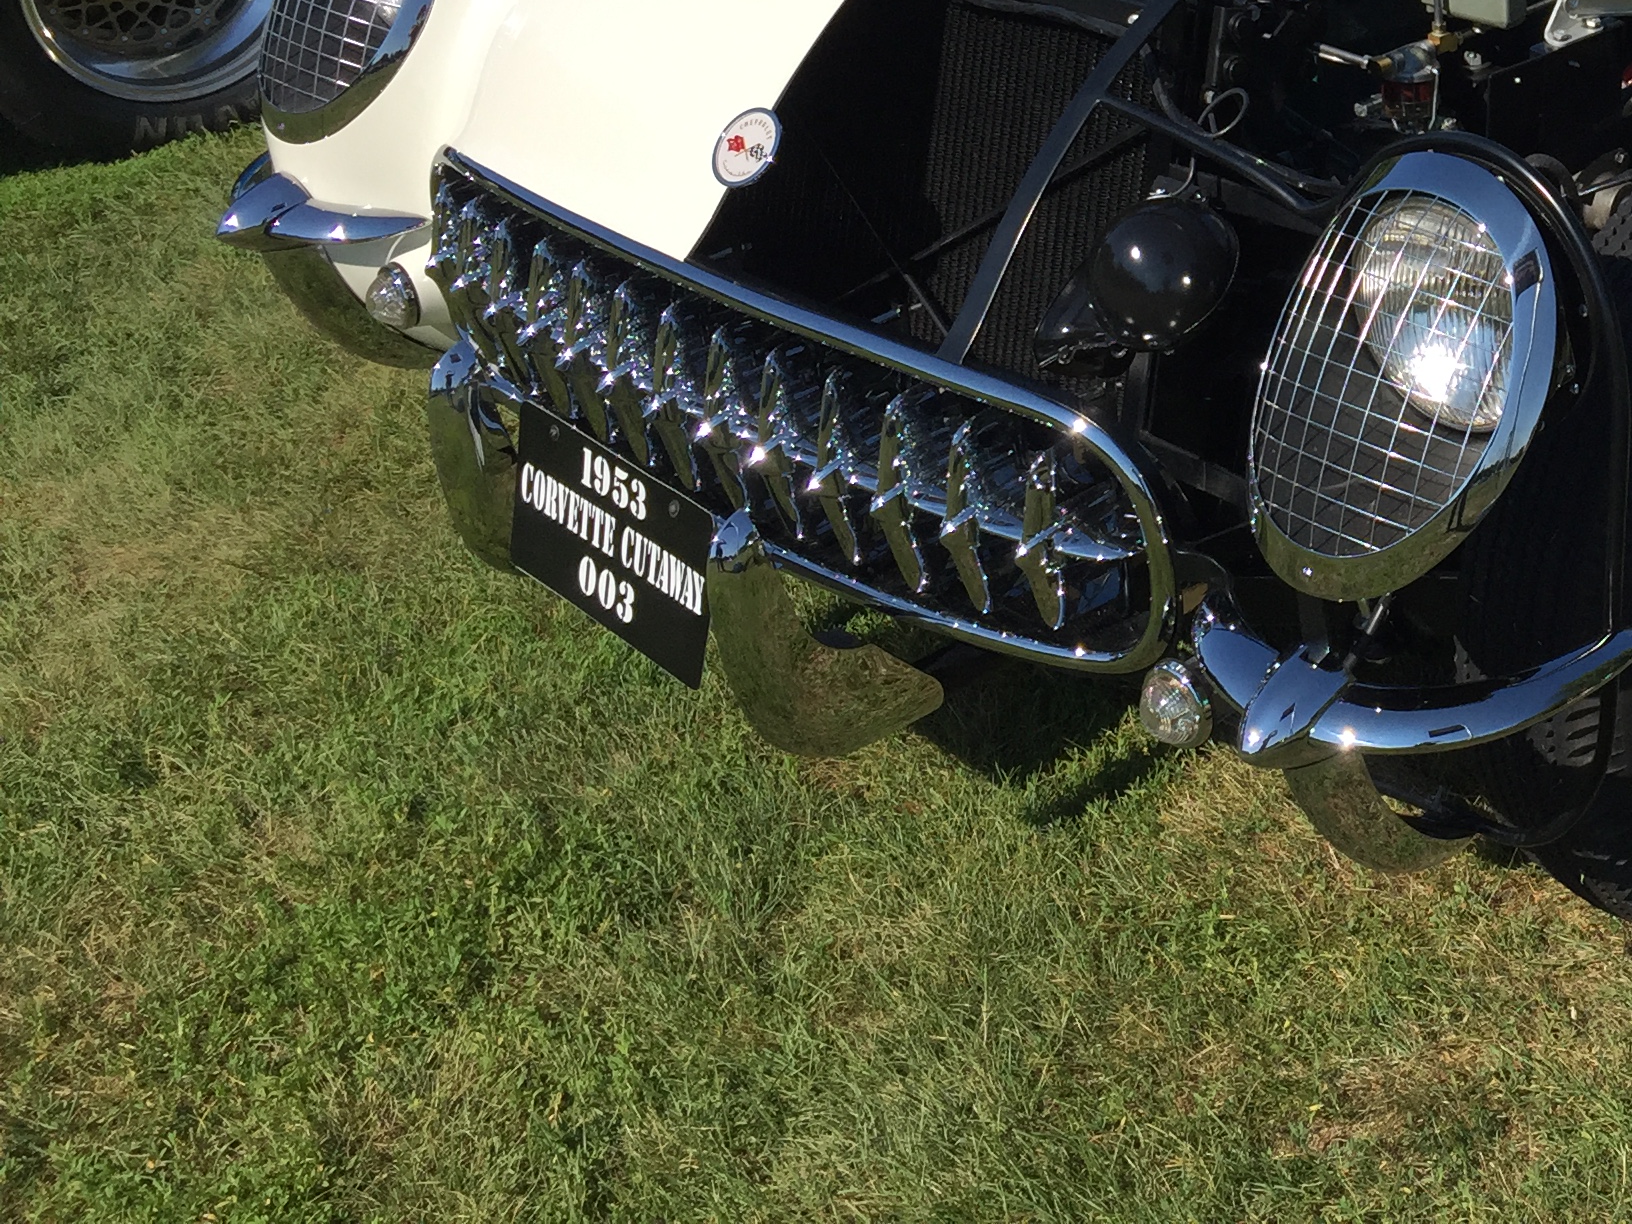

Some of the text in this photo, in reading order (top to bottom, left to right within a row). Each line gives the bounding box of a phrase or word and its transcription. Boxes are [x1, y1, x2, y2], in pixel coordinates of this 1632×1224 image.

[581, 447, 647, 521] 1953
[521, 462, 705, 616] CORVETTE CUTAWAY
[578, 555, 635, 623] 003
